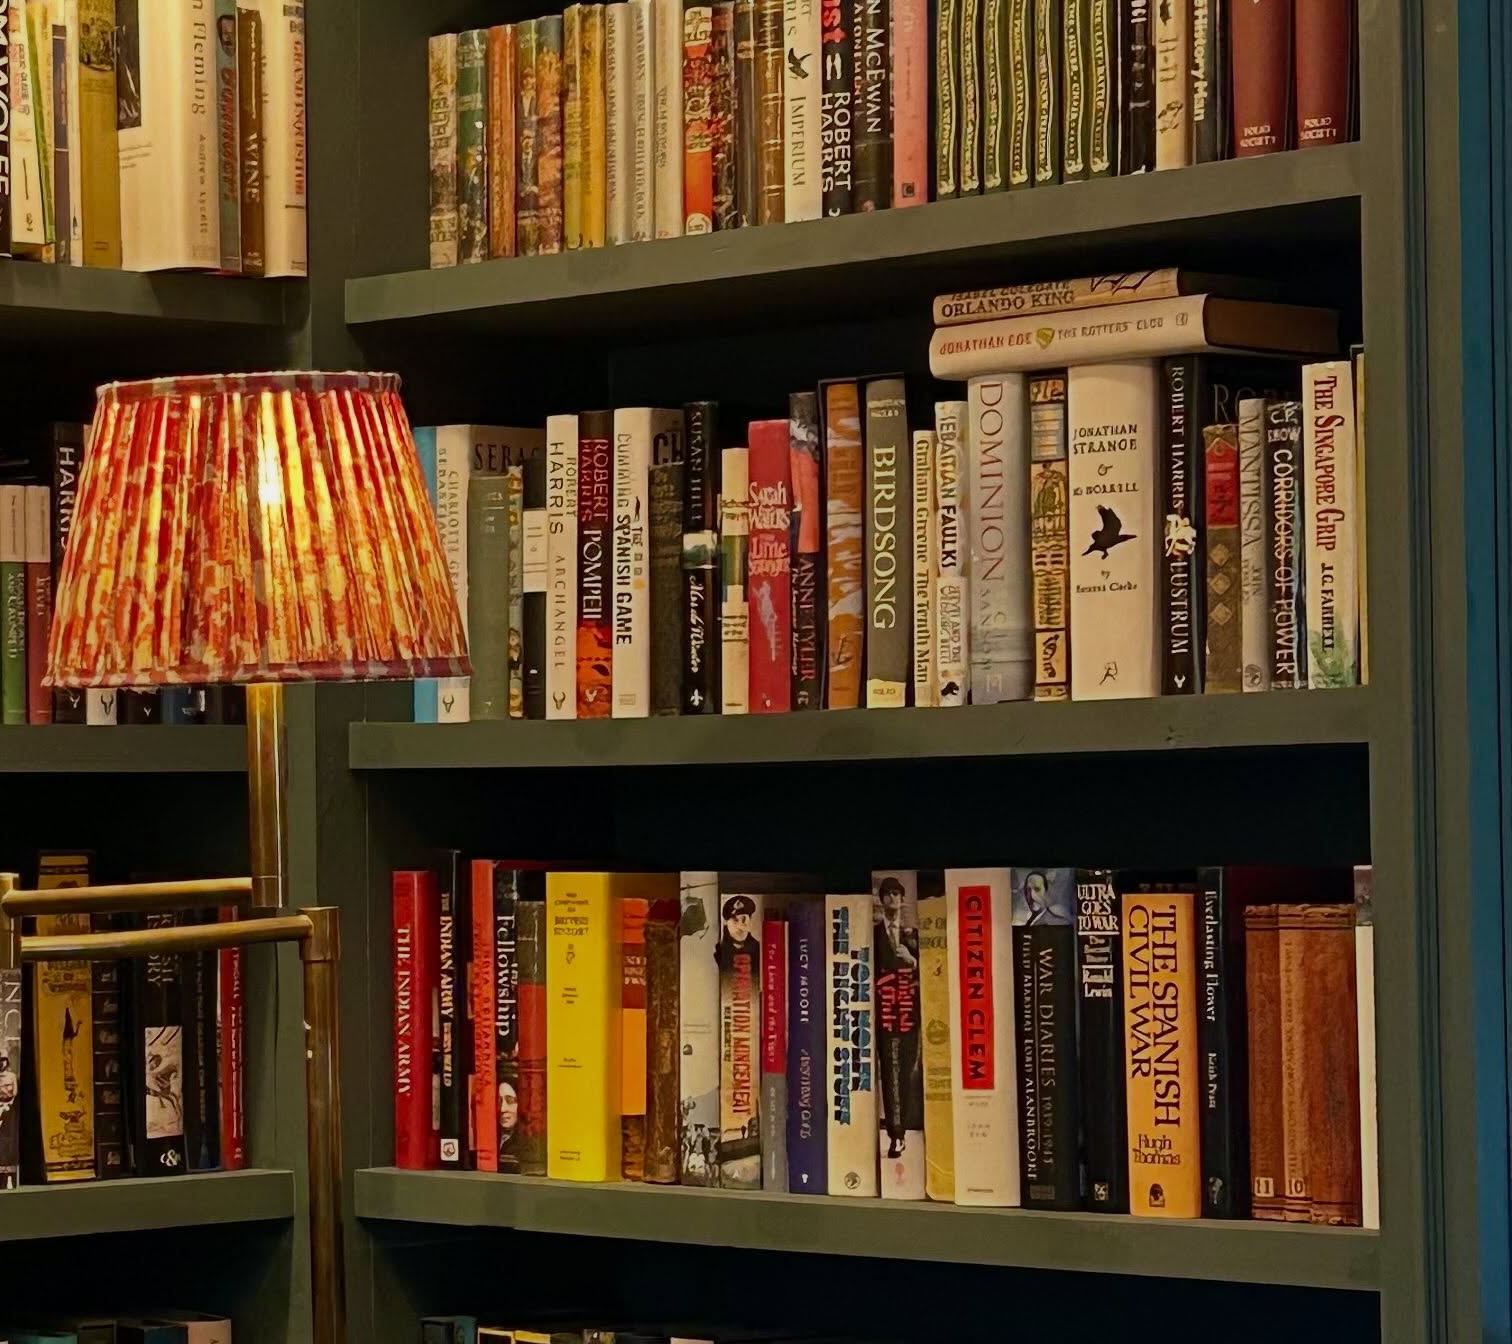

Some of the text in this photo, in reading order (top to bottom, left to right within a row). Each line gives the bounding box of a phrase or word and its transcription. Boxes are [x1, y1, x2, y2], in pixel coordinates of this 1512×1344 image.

[191, 22, 209, 116] Fleming
[1190, 14, 1208, 81] History
[1194, 81, 1208, 121] Man
[244, 132, 260, 204] WINE
[834, 92, 851, 192] ROBERT
[941, 289, 1075, 318] ORLANDO KING
[549, 441, 565, 535] HARRIS
[592, 438, 609, 522] ROBERT
[748, 481, 788, 507] Sarah
[978, 383, 1006, 581] DOMINION
[1170, 366, 1186, 509] ROBERT HARRIS
[1240, 413, 1263, 547] MANTISSA
[1313, 375, 1345, 551] THE SINGAPORE GRIP
[614, 514, 634, 645] SPANISH GAME
[873, 445, 897, 629] BIRDSONG
[916, 439, 930, 683] Graham Greene The Tenth Man
[1273, 449, 1296, 676] CORRIDORS OF POWER
[552, 554, 568, 669] ARCHANGEL
[1170, 561, 1188, 654] LUSTRUM
[439, 916, 455, 971] INDIAN
[439, 974, 455, 1019] ARMY
[495, 914, 515, 1038] Fellowship
[896, 967, 913, 1033] English
[965, 894, 985, 1081] CITIZEN CLEM
[1128, 904, 1152, 1078] CIVIL WAR
[394, 924, 412, 1097] THE INDIAN ARMY
[831, 906, 851, 1126] THE RIGHT STUFF
[851, 946, 871, 1093] TOM WOLFE
[1038, 947, 1057, 1087] WAR DIARIES
[1152, 904, 1182, 1128] THE SPANISH
[732, 1037, 751, 1117] MINCEMEAT
